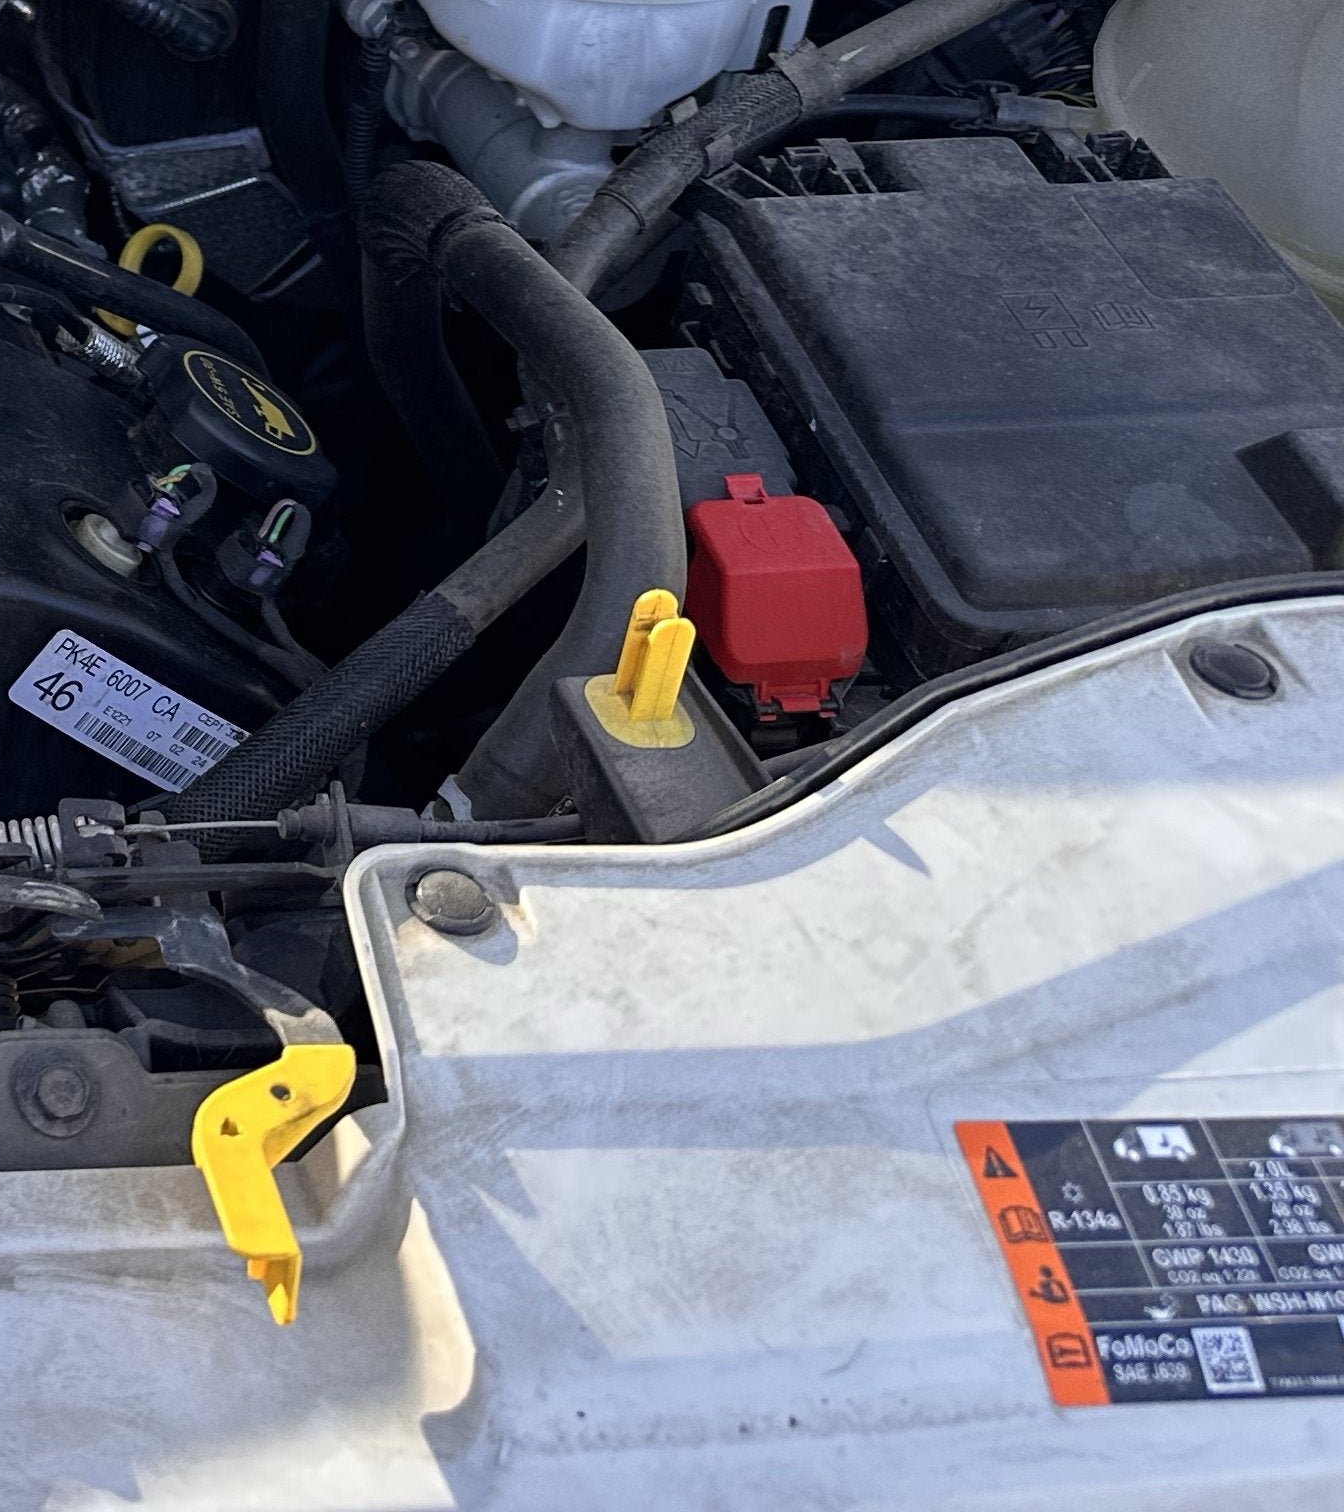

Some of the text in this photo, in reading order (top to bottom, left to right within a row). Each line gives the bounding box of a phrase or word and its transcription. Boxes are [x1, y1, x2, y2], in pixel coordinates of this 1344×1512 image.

[54, 637, 181, 722] PK4E 6007 CA
[33, 672, 83, 712] 46
[146, 730, 162, 742] 07
[168, 743, 185, 756] 02
[191, 755, 208, 769] 24
[1182, 1184, 1215, 1208] kg
[1288, 1180, 1322, 1207] kg
[1048, 1209, 1122, 1232] R-134a
[1152, 1245, 1260, 1267] GWP 1430
[1167, 1270, 1201, 1284] CO2
[1277, 1266, 1311, 1280] CO2
[1195, 1294, 1248, 1315] PAG
[1096, 1333, 1196, 1359] FoMoCo
[1112, 1361, 1193, 1384] SAE J639
